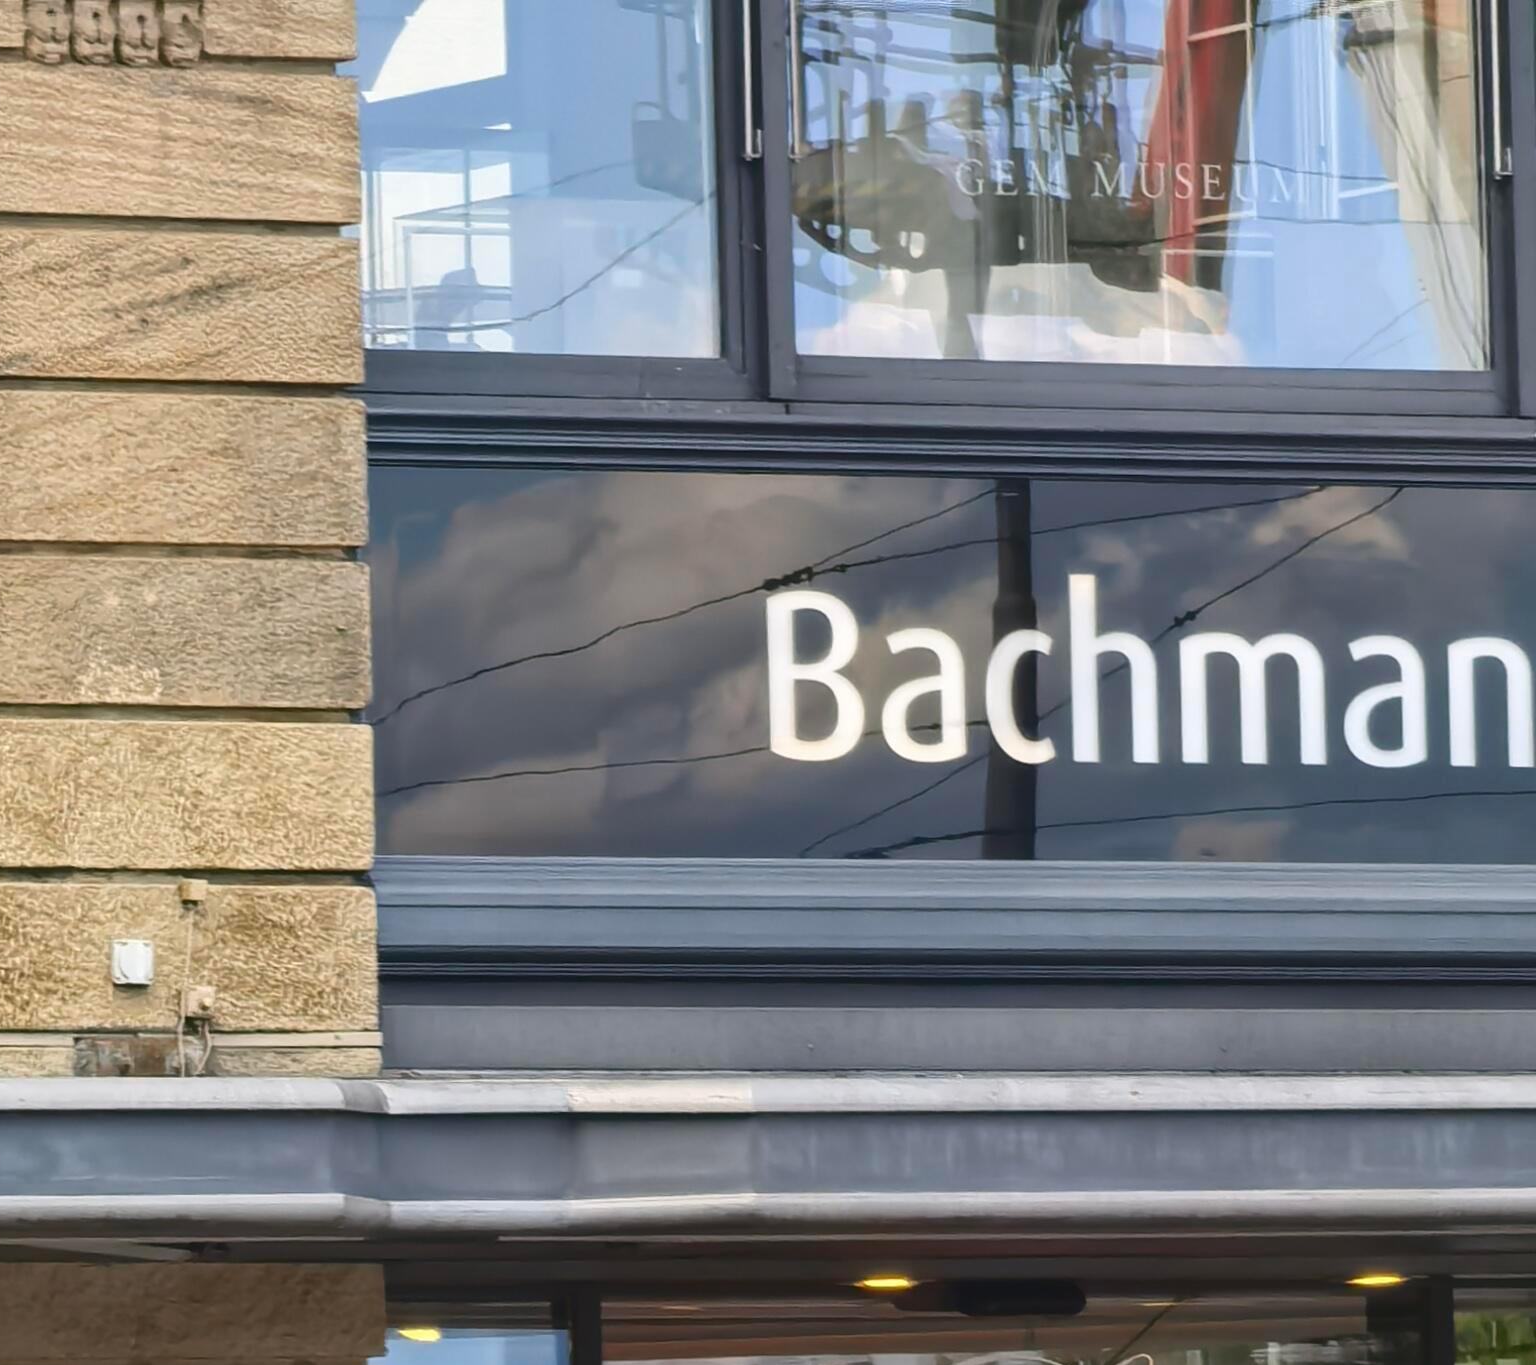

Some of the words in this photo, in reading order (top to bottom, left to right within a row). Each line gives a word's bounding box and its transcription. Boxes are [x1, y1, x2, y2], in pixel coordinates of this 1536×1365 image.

[955, 157, 1069, 199] GEM
[1089, 160, 1305, 204] MUSEUM
[766, 573, 1535, 768] Bachman
